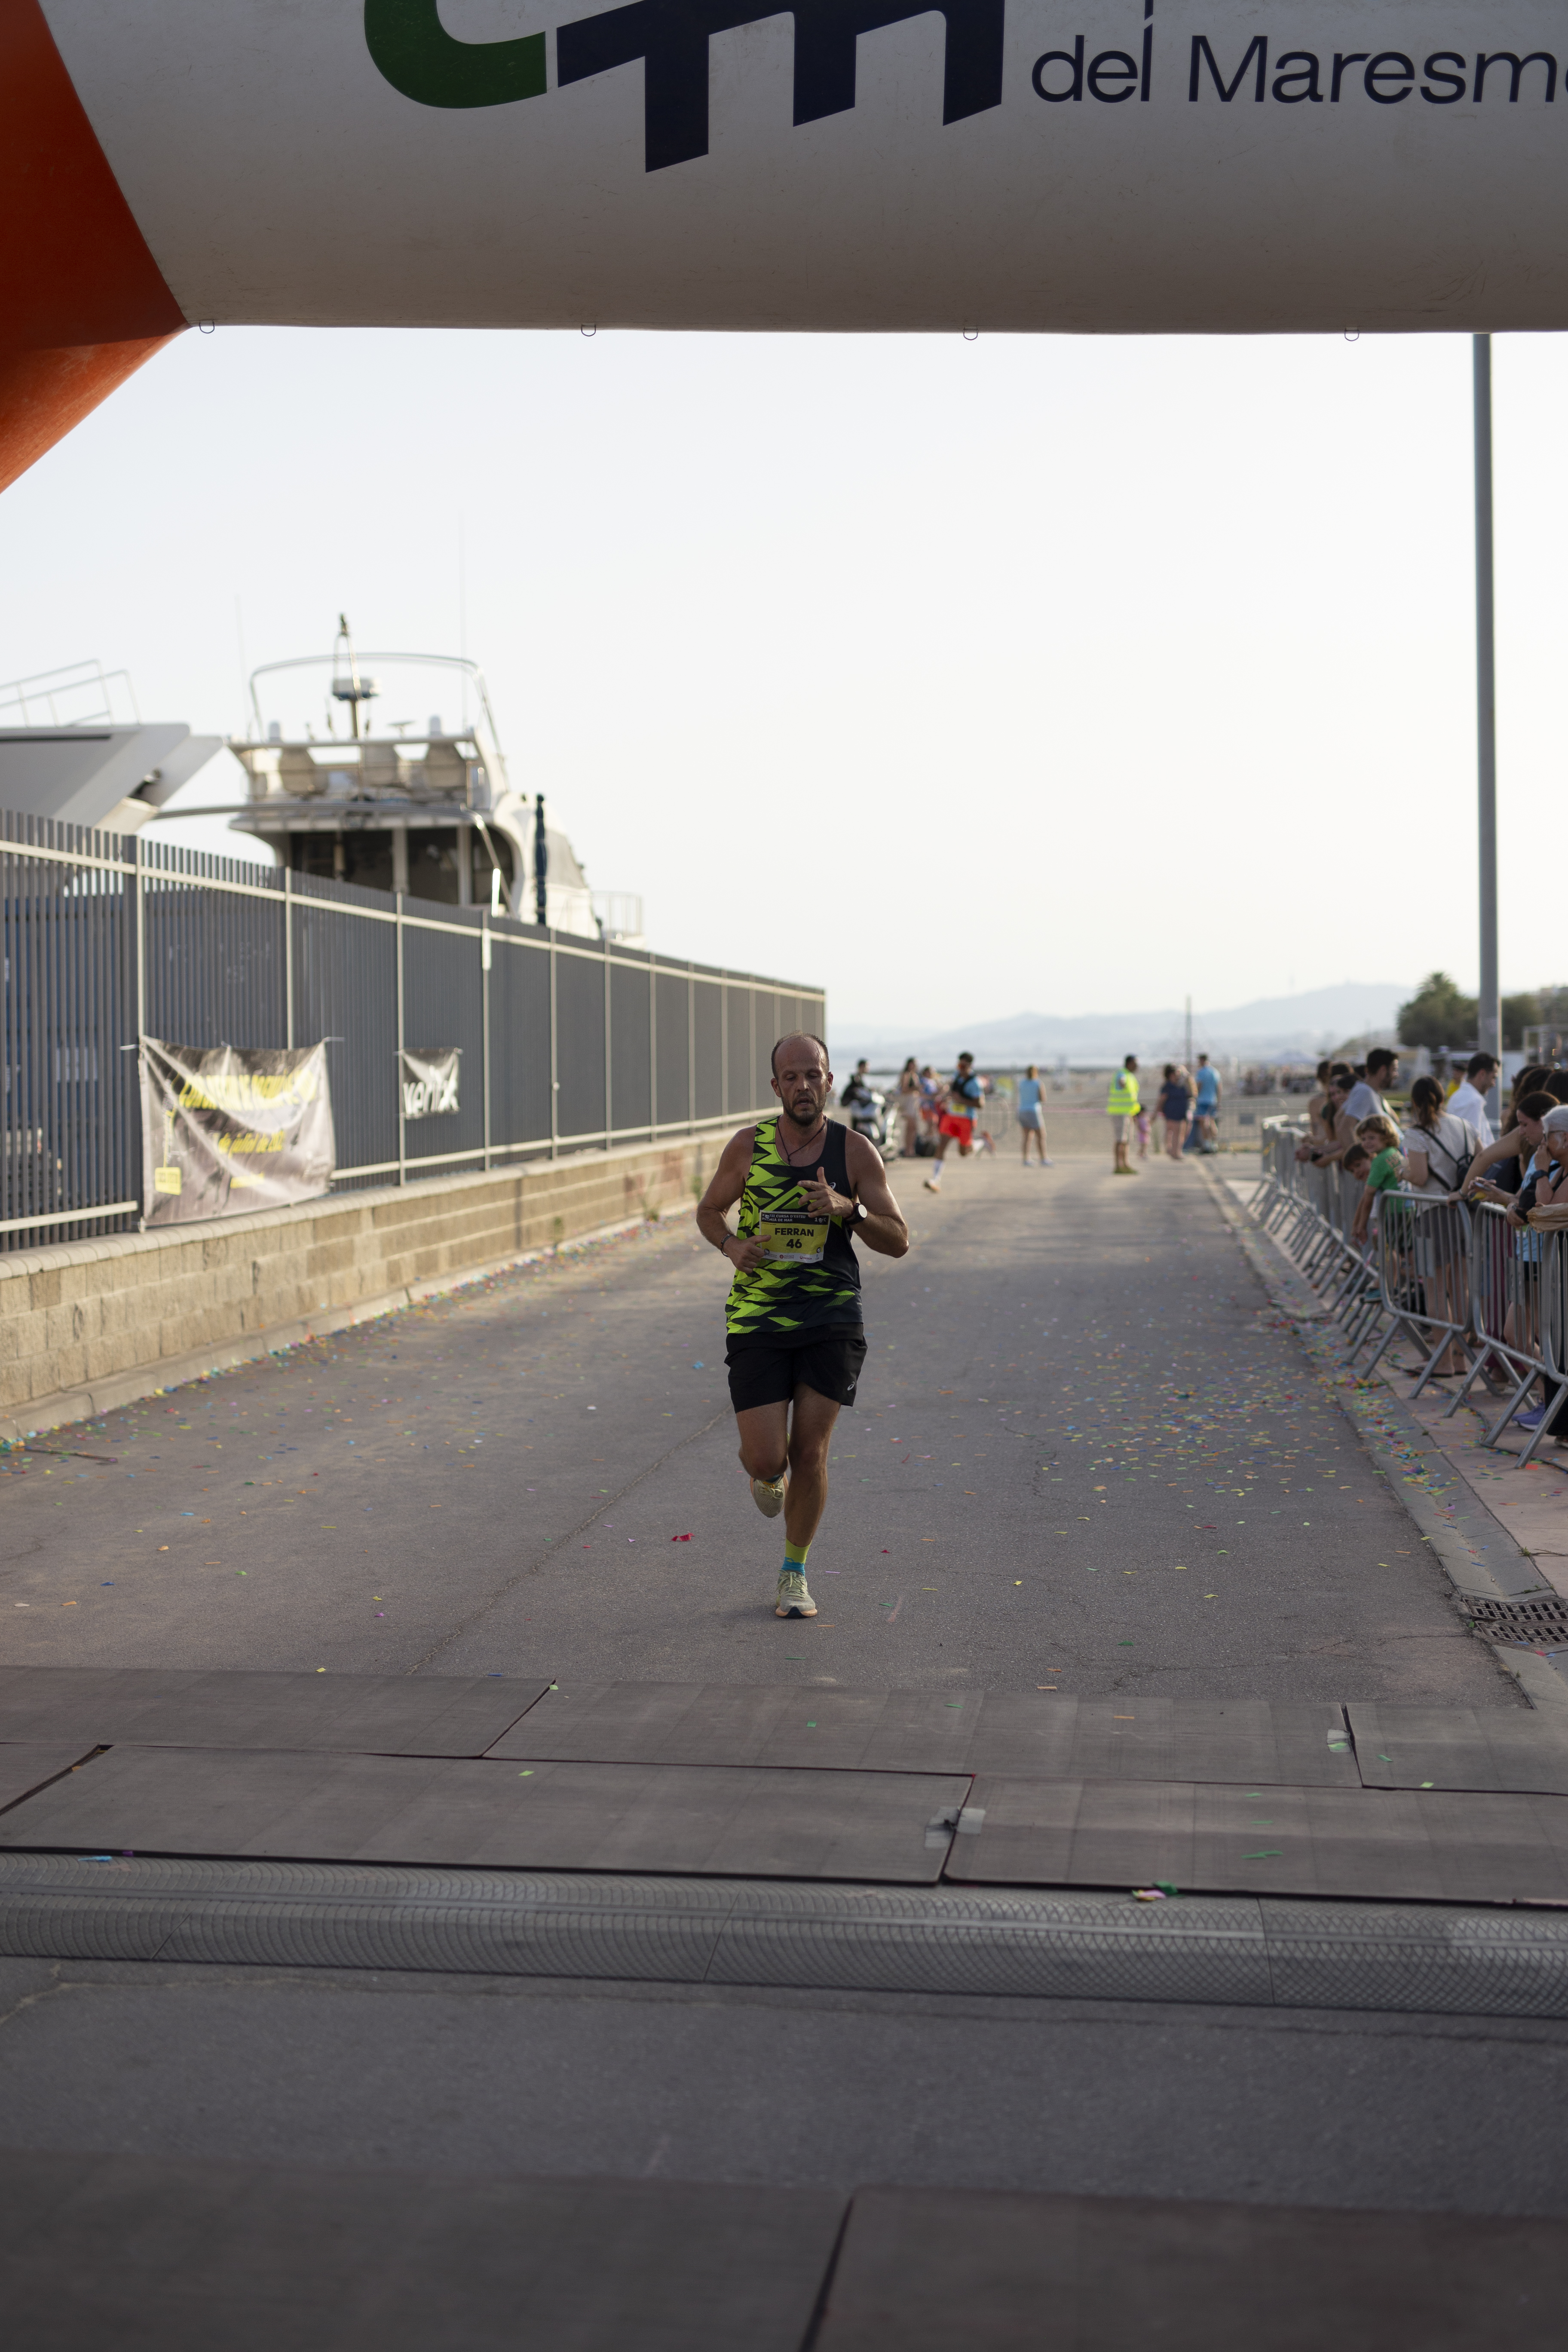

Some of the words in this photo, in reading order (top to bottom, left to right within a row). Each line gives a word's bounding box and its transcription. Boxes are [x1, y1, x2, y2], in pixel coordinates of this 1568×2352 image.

[1032, 23, 1153, 103] del
[1188, 35, 1568, 104] Maresm
[775, 1228, 814, 1237] FERRAN
[786, 1239, 802, 1248] 46
